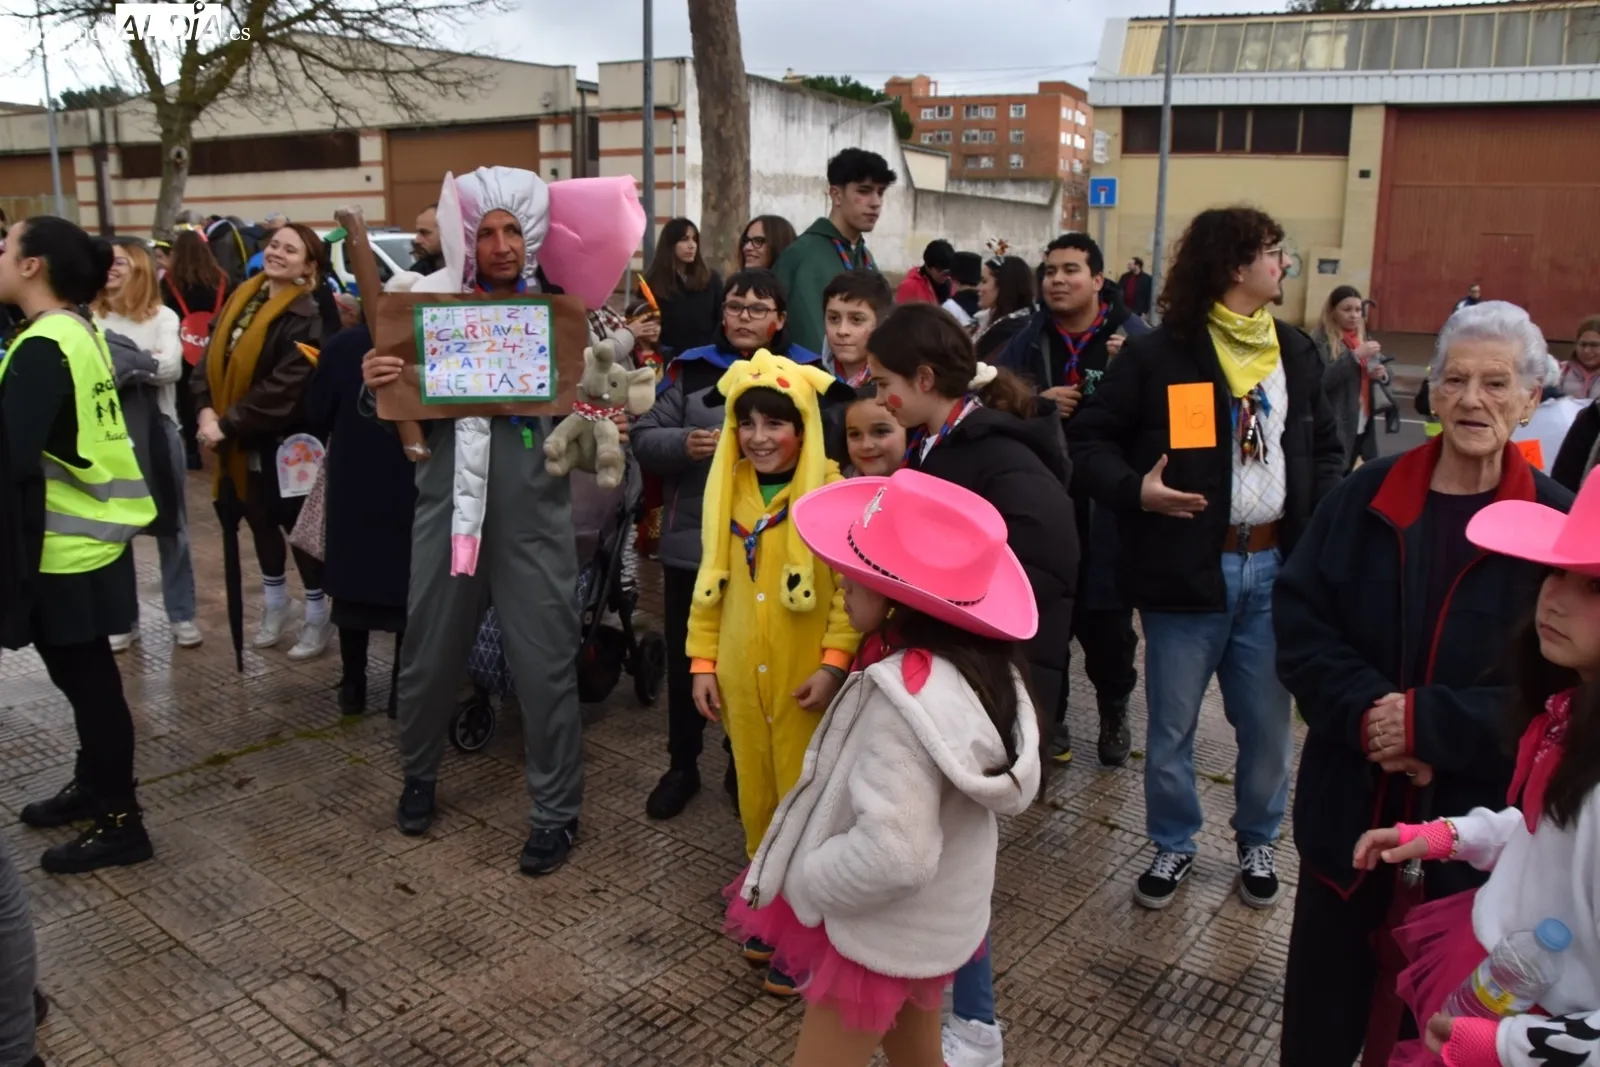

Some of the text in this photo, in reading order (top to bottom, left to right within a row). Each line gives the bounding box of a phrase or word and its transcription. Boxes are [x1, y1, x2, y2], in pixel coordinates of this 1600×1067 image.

[450, 307, 520, 325] FELIZ
[436, 322, 539, 341] CARNAVAL
[445, 357, 516, 369] HATHI
[435, 373, 532, 394] FIESTAS
